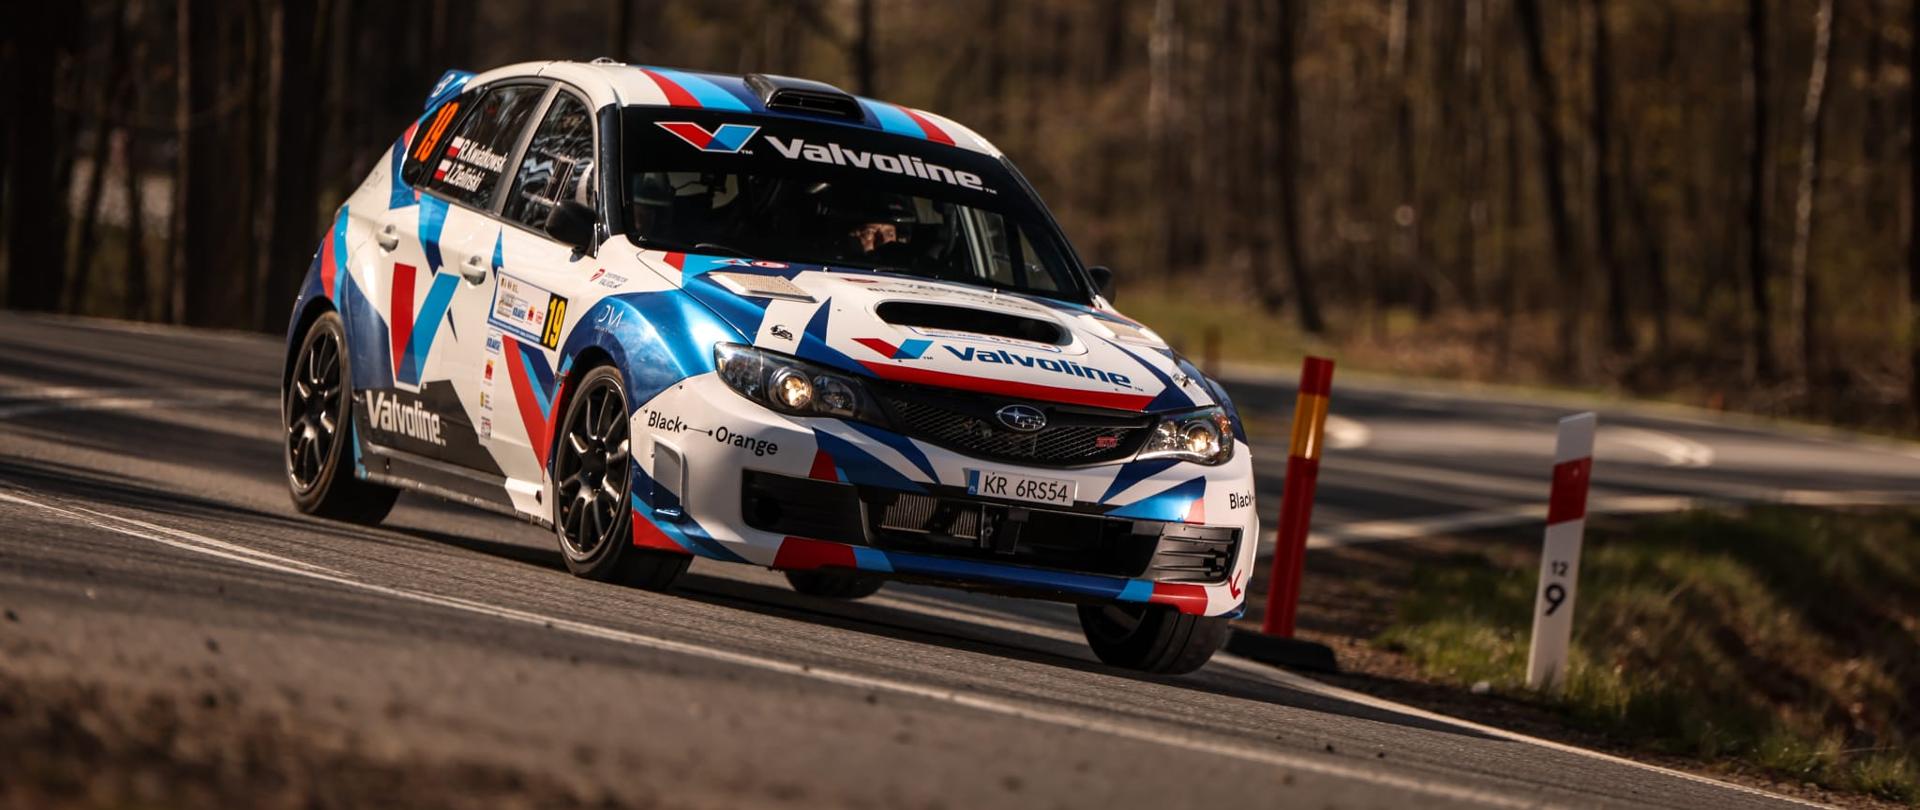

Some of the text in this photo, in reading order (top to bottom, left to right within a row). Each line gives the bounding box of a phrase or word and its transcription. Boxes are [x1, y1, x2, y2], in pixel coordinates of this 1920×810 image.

[414, 102, 460, 163] 19
[764, 135, 985, 192] Valvoline
[543, 298, 566, 348] 19
[942, 344, 1133, 389] Valvoline
[366, 389, 441, 446] Valvoline
[648, 411, 778, 457] Black Orange
[984, 474, 1068, 503] KR 6RS54
[1229, 490, 1252, 510] Black
[1551, 560, 1568, 577] 12
[1544, 583, 1566, 616] 9
